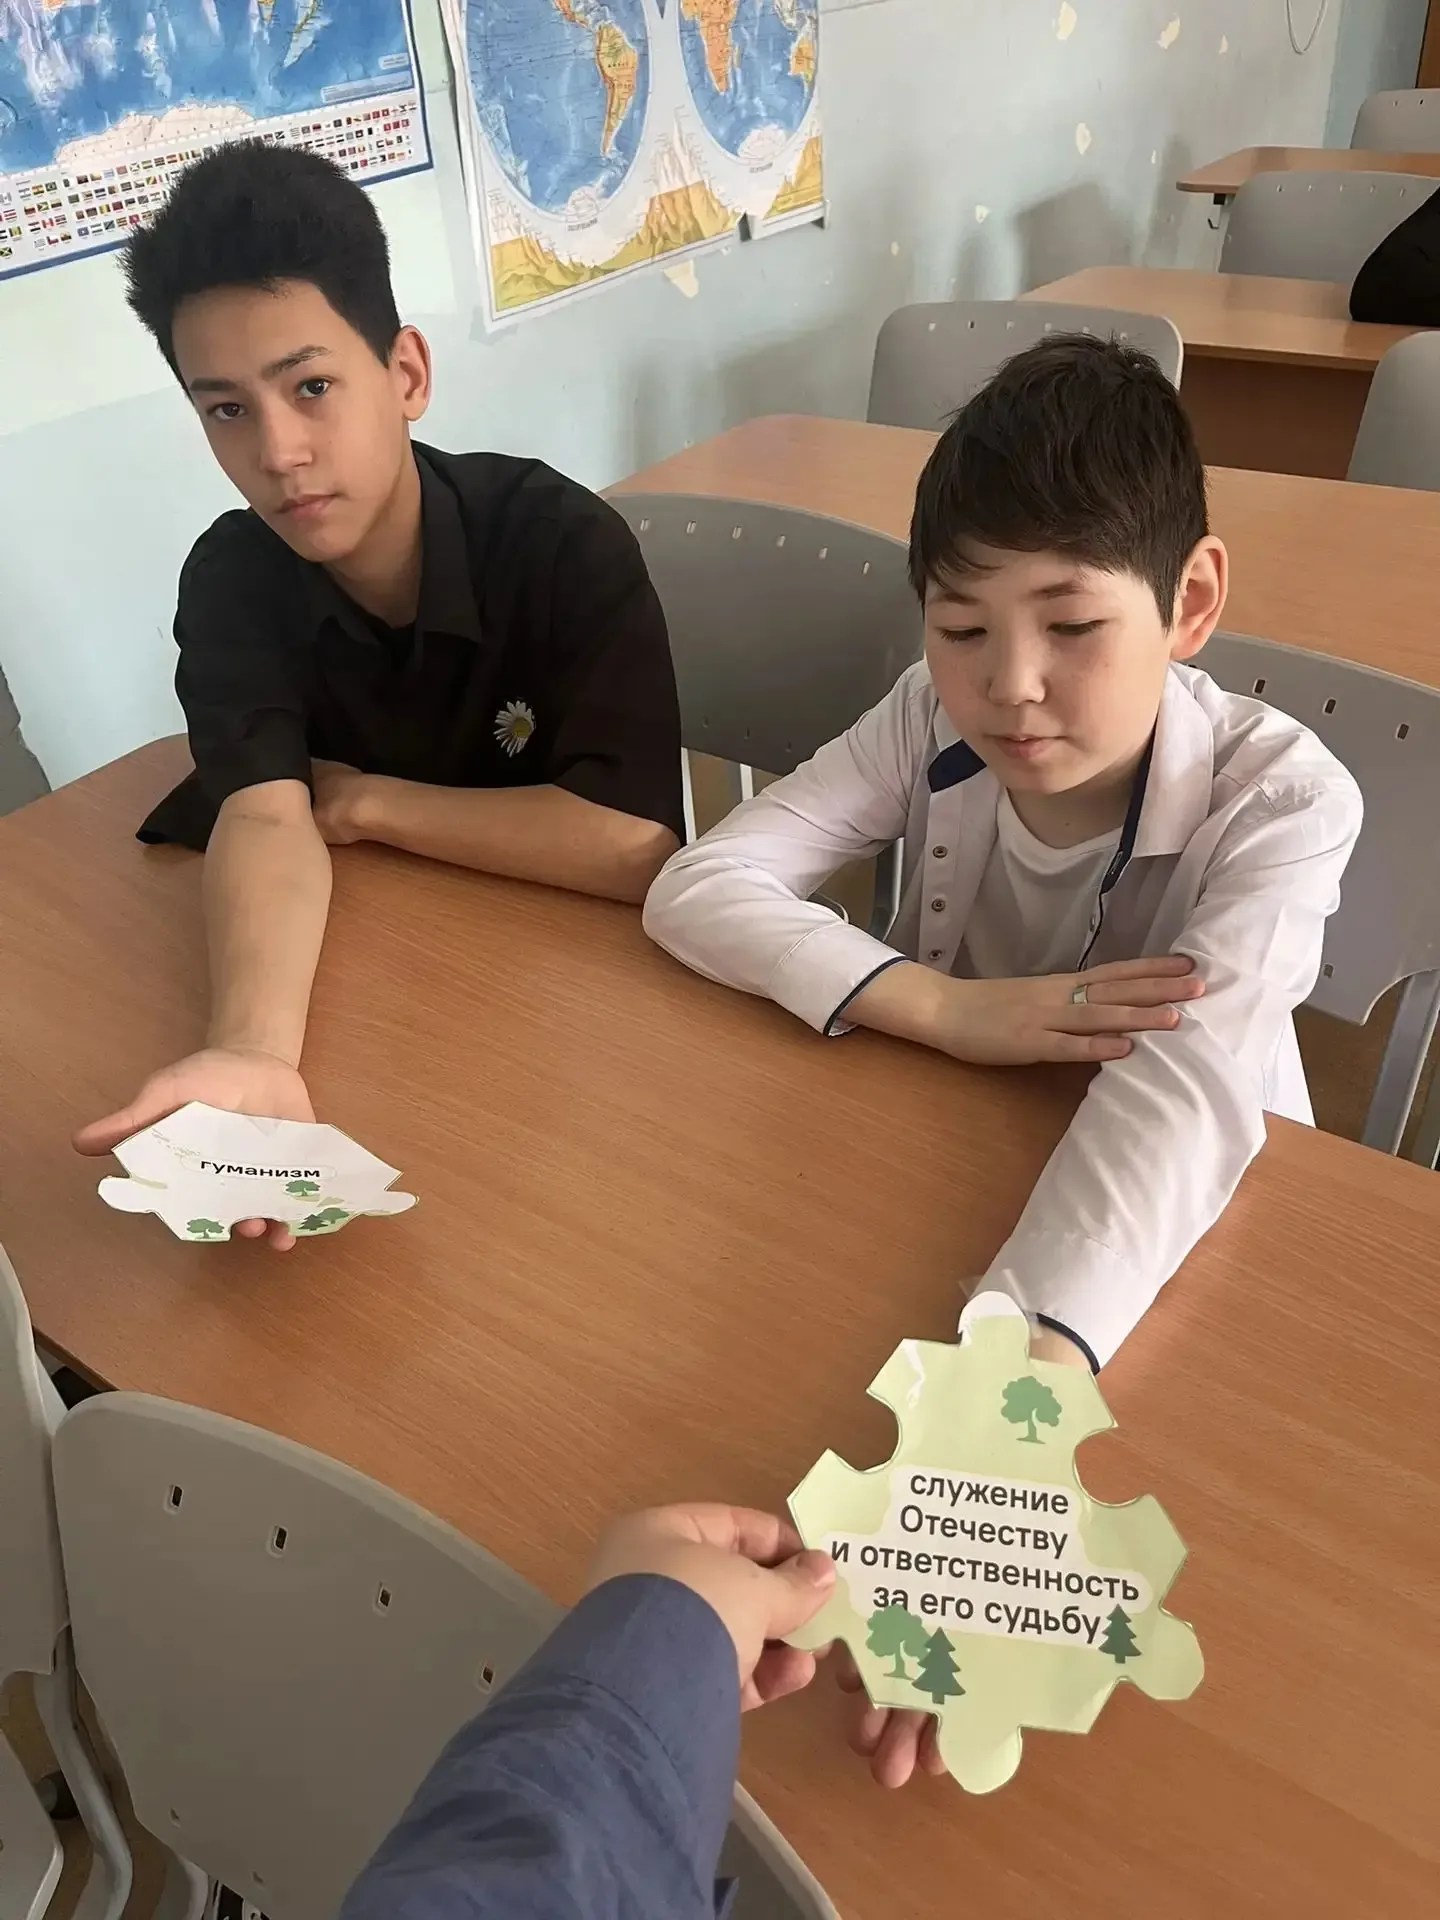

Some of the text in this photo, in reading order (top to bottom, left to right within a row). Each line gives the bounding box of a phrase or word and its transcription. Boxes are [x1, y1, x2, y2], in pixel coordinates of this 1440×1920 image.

[200, 1159, 320, 1178] гуманизм
[910, 1473, 1069, 1514] служение
[899, 1504, 1068, 1559] Отечеству
[830, 1540, 1140, 1602] и ответственность
[873, 1586, 1102, 1644] за его судьбу
